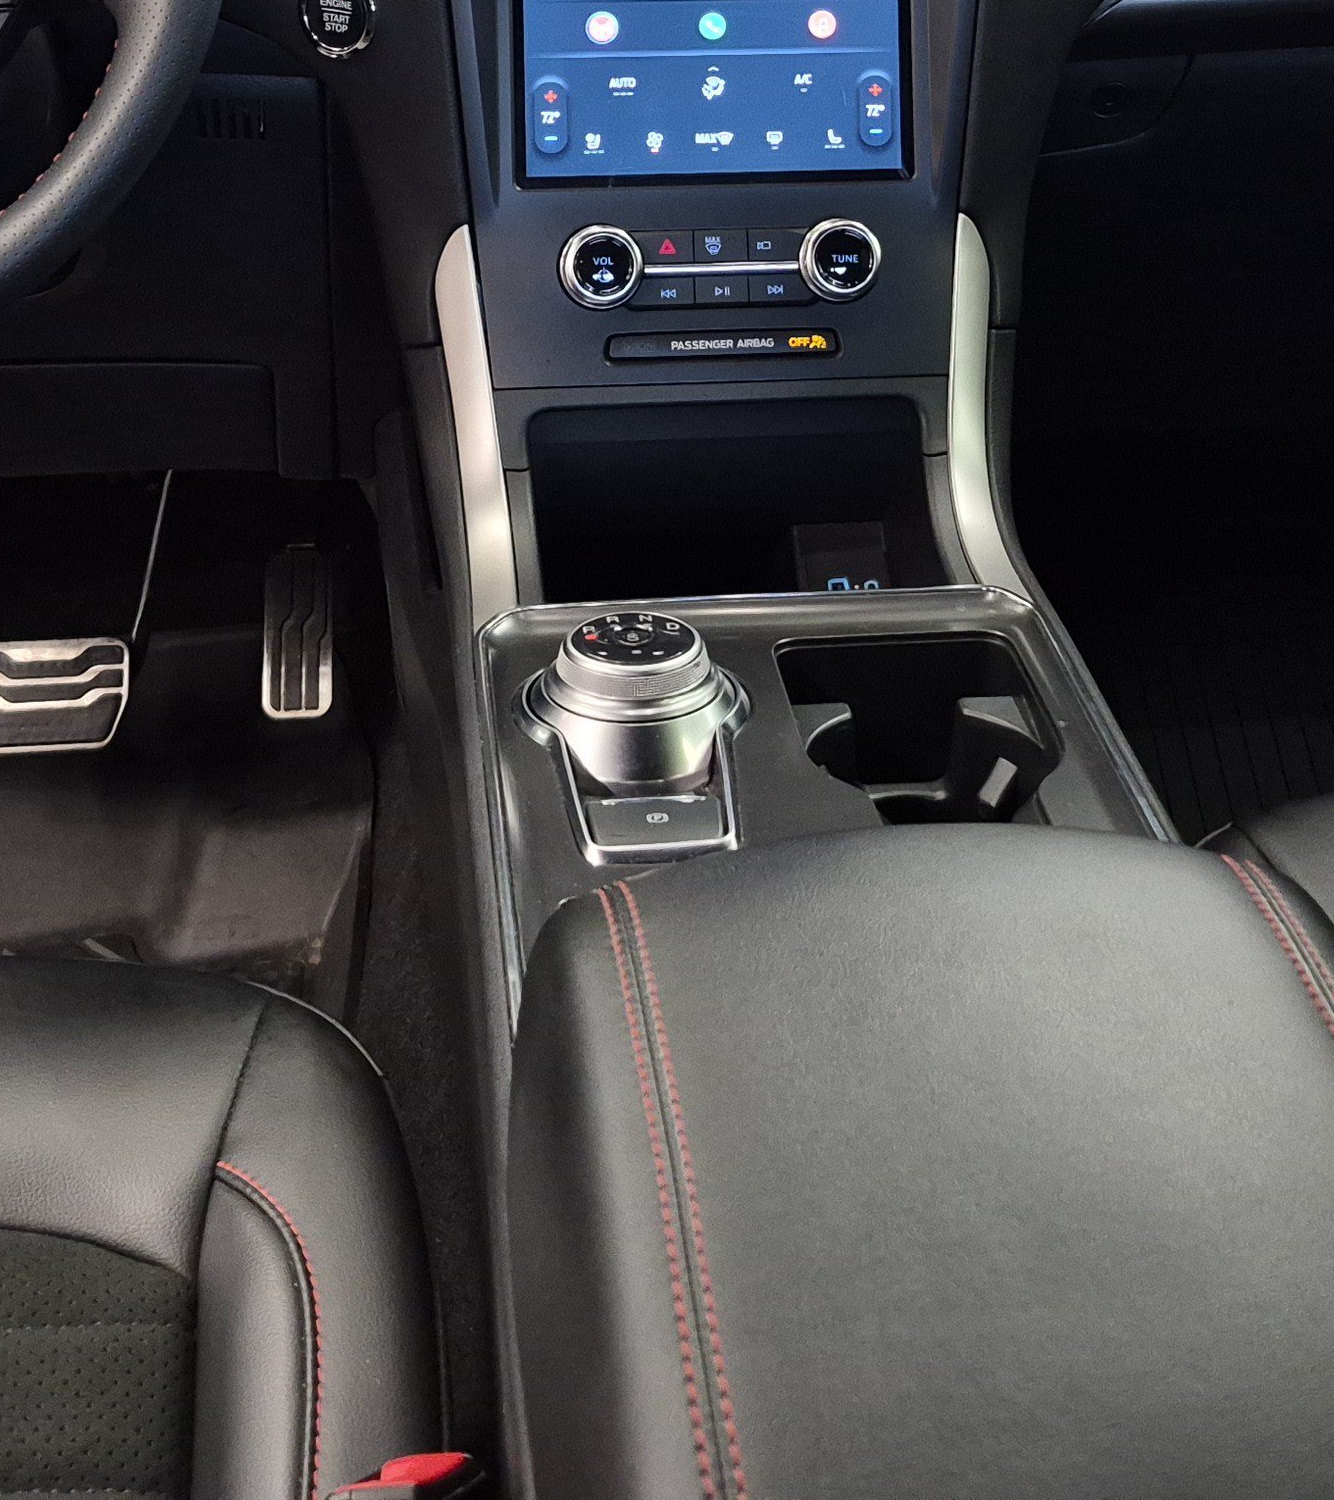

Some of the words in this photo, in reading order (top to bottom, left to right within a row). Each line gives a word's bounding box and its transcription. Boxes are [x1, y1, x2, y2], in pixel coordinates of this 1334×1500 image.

[323, 13, 350, 24] START
[325, 22, 348, 33] STOP
[609, 77, 636, 89] AUTO
[794, 73, 813, 85] A/C
[695, 132, 717, 145] MAX
[704, 236, 721, 244] MAX
[593, 256, 614, 266] VOL
[831, 254, 859, 264] TUNE
[671, 339, 734, 351] PASSENGER
[736, 337, 774, 348] AIRBAG
[788, 336, 810, 349] OFF
[638, 614, 652, 622] N
[665, 622, 680, 630] D
